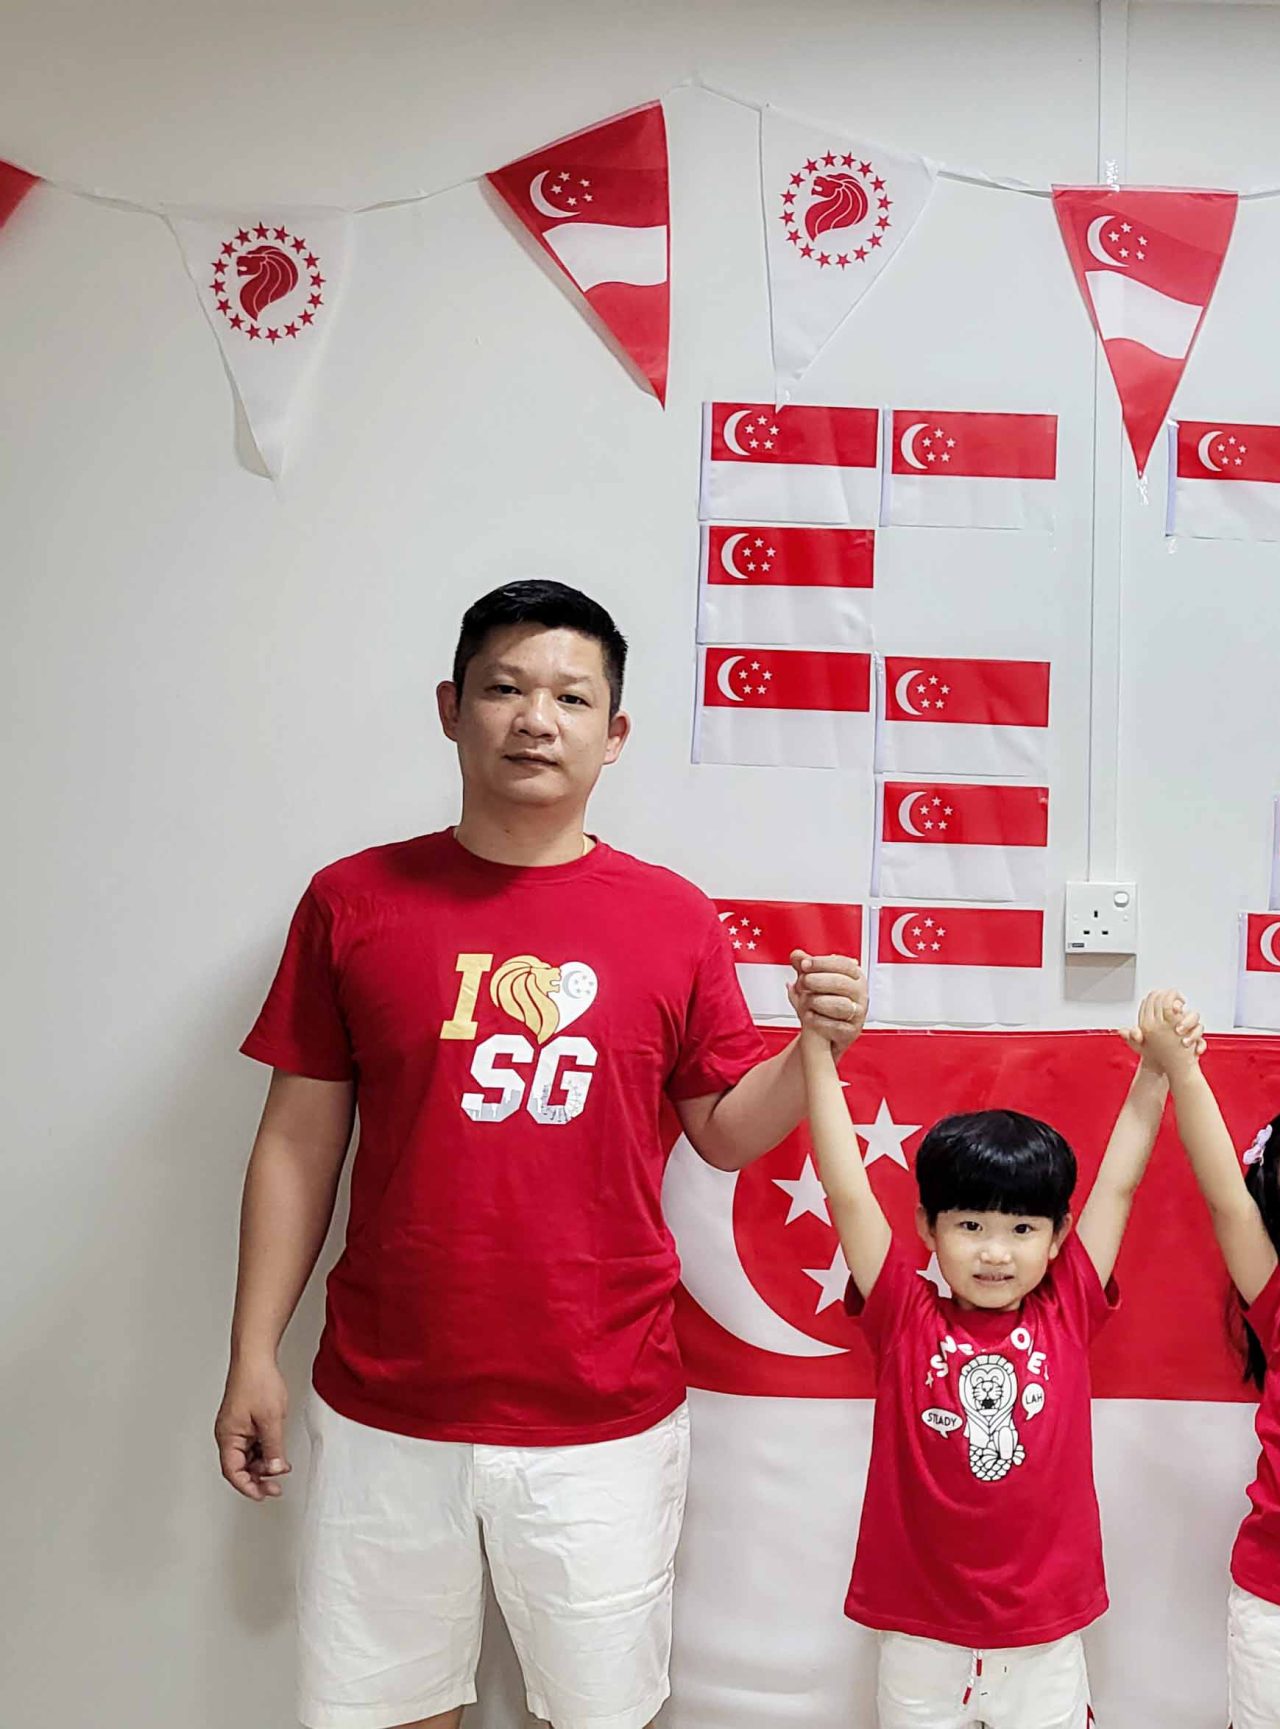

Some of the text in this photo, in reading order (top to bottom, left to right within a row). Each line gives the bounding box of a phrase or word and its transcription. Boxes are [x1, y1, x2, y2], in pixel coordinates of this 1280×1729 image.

[439, 953, 494, 1040] I
[460, 1033, 598, 1125] SG
[1025, 1393, 1043, 1405] LAH
